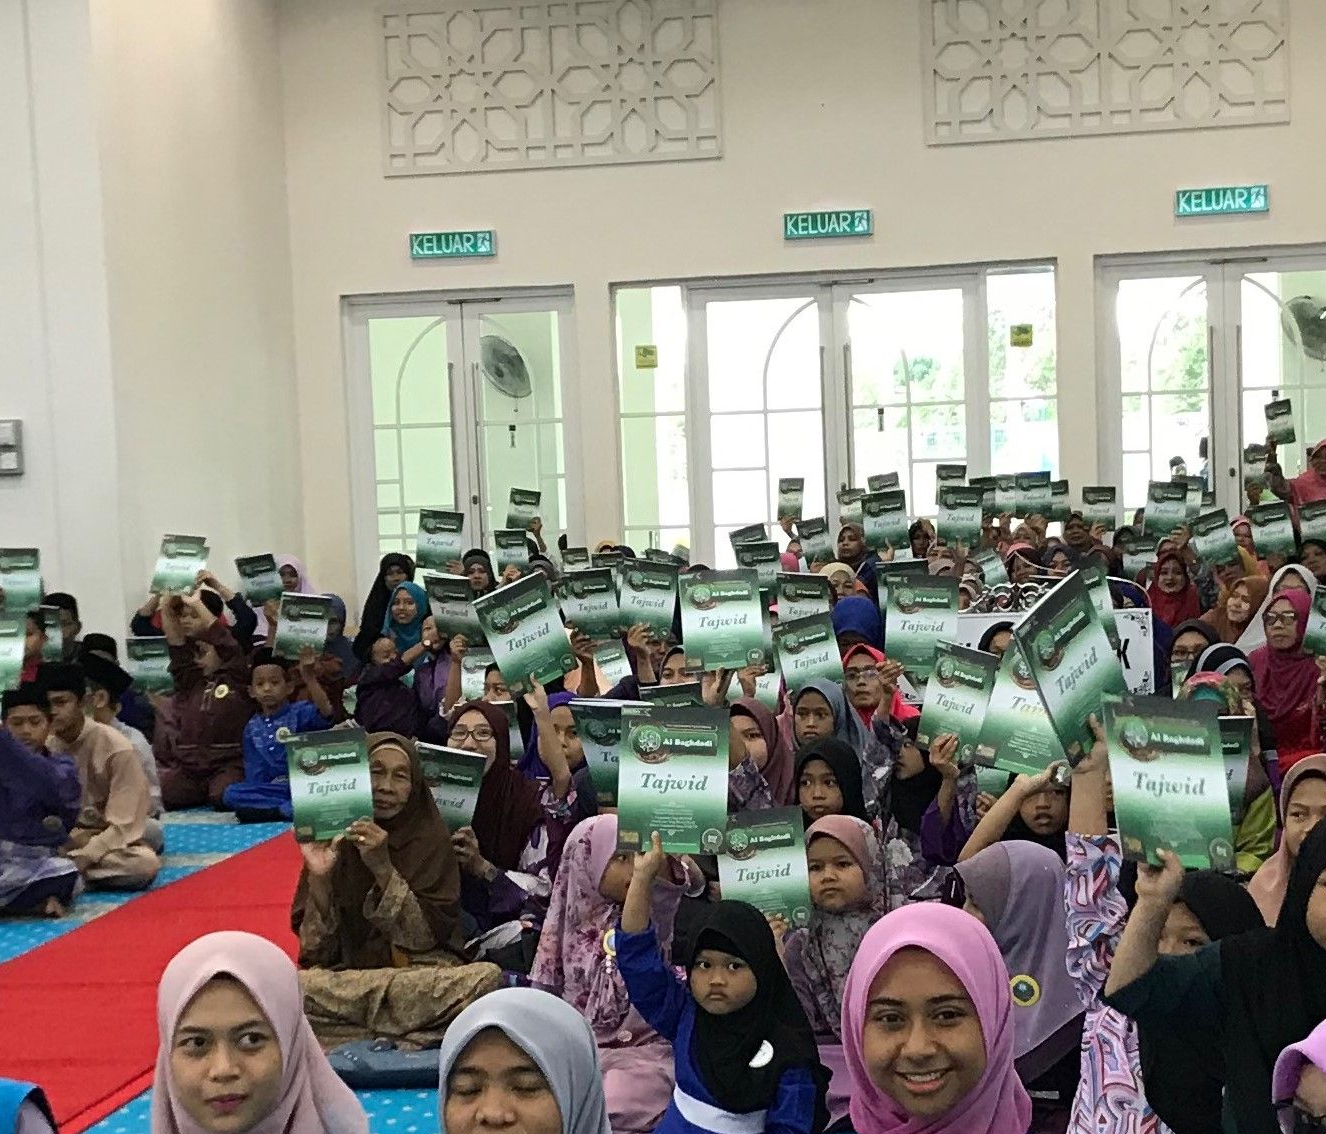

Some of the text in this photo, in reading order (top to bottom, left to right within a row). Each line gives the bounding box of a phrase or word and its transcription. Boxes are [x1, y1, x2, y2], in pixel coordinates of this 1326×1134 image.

[1179, 189, 1247, 212] KELUAR
[787, 213, 851, 235] KELUAR
[413, 234, 474, 254] KELUAR
[426, 537, 454, 547] Tajwid
[578, 602, 607, 611] Tajwid
[631, 595, 665, 607] Tajwid
[699, 614, 747, 630] Tajwid
[900, 620, 943, 633] Tajwid
[506, 623, 549, 651] Tajwid
[793, 651, 829, 669] Tajwid
[1056, 647, 1098, 695] Tajwid
[936, 693, 973, 715] Tajwid
[663, 737, 712, 750] Al Baghdadi
[307, 778, 356, 795] Tajwid
[641, 773, 708, 792] Tajwid
[1133, 772, 1205, 797] Tajwid
[737, 863, 791, 882] Tajwid
